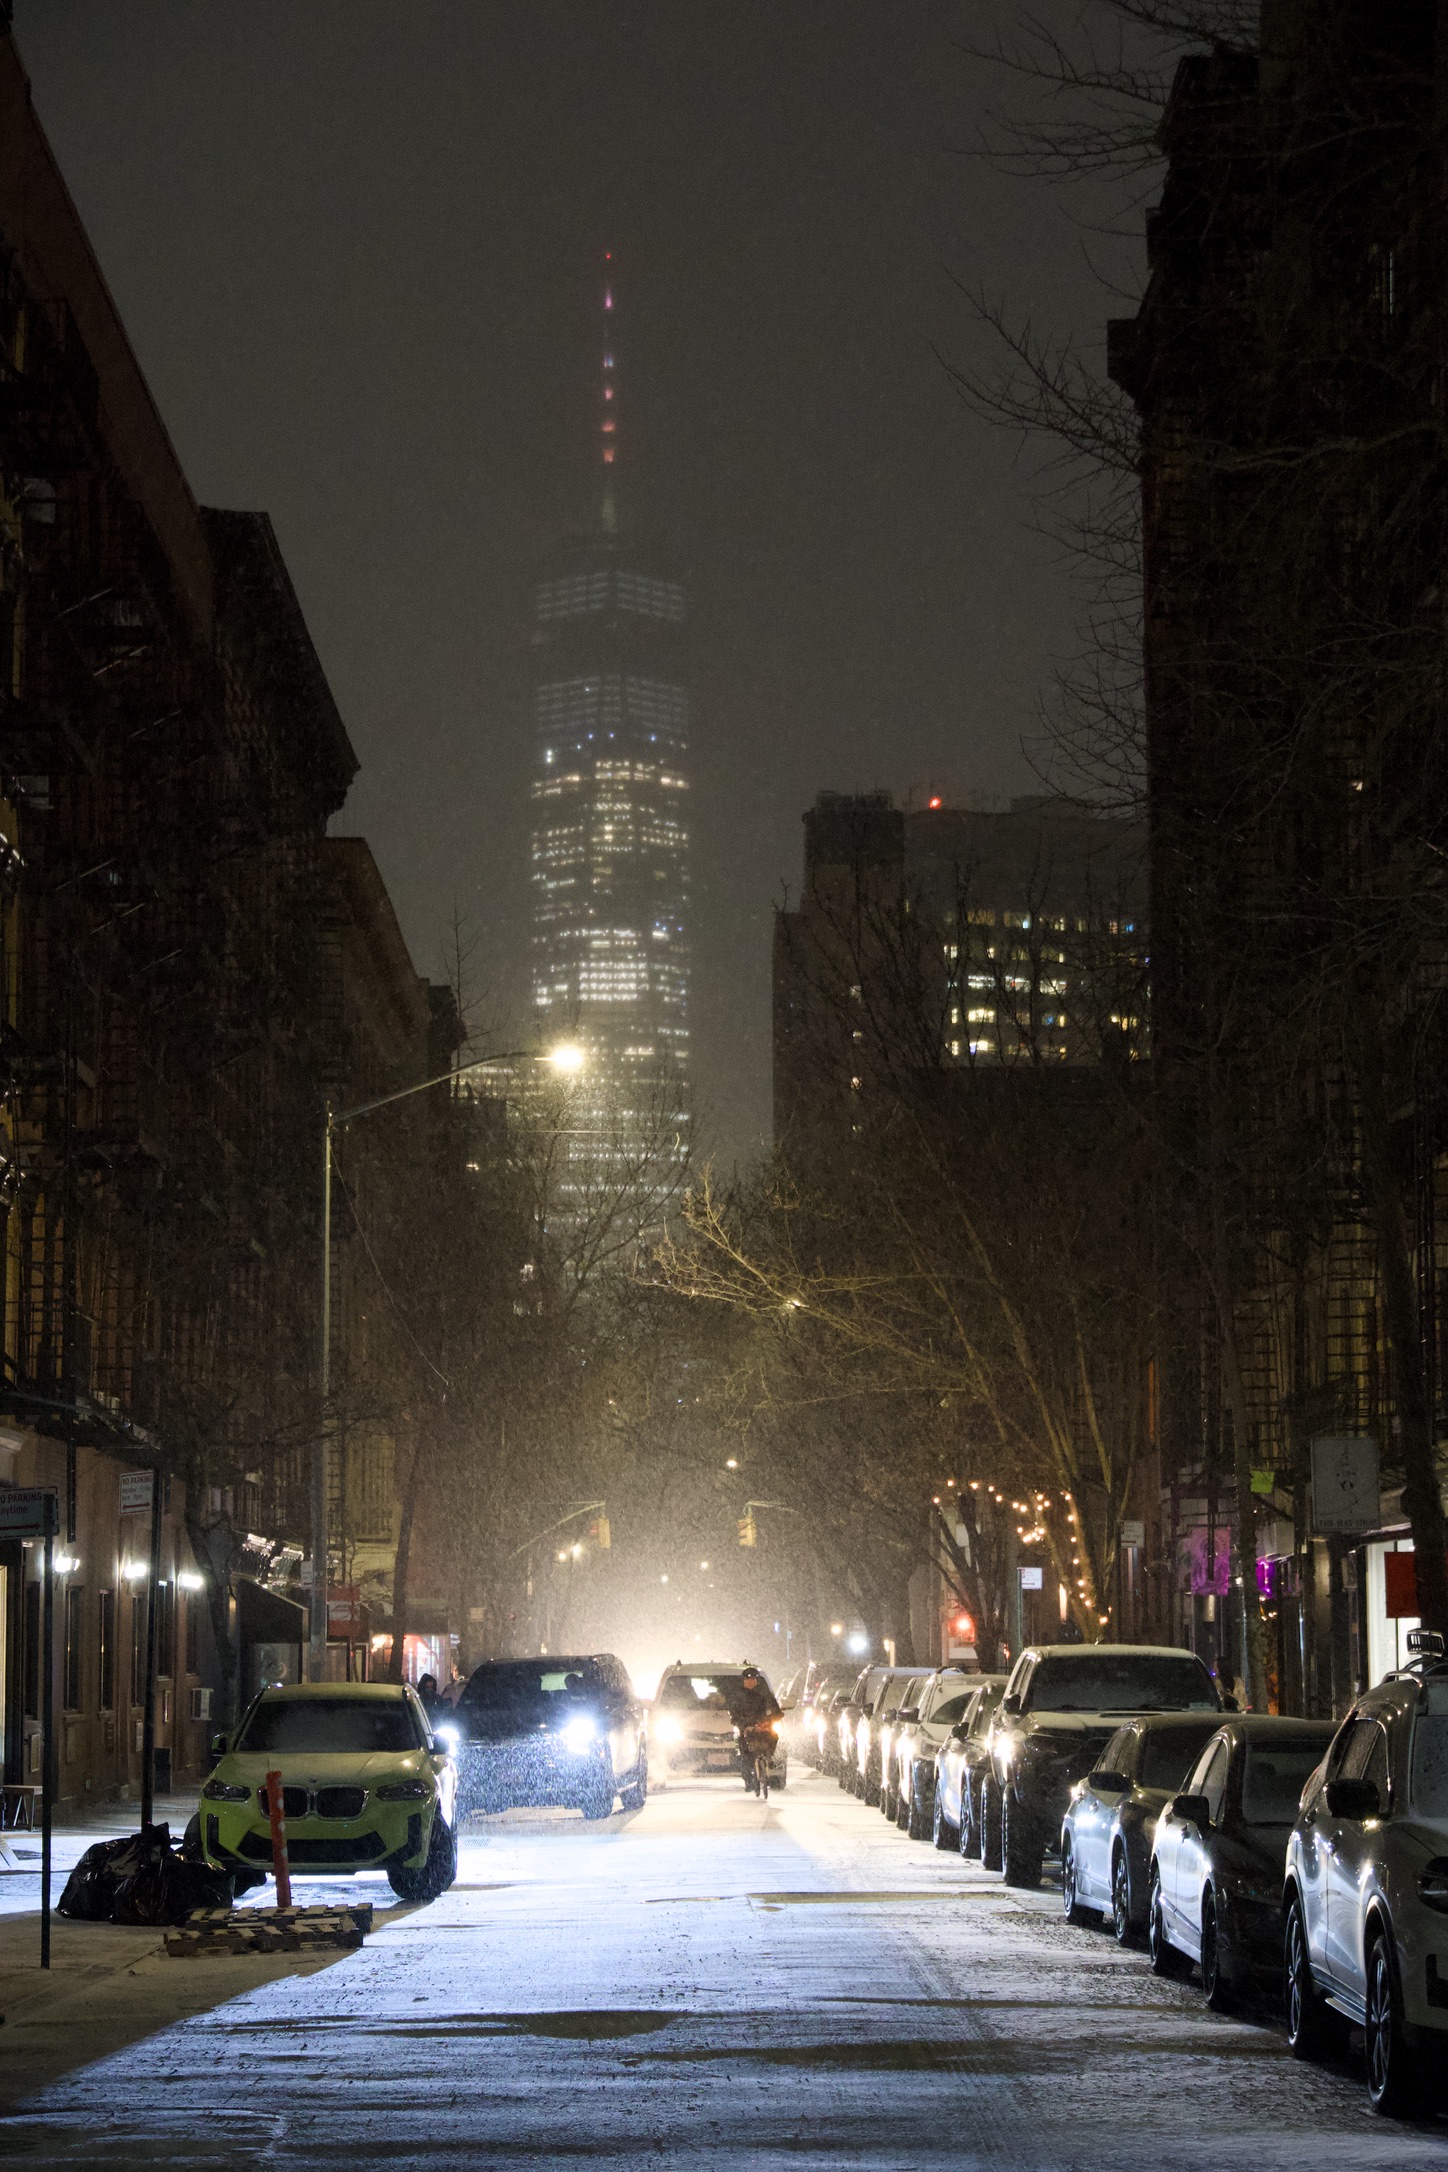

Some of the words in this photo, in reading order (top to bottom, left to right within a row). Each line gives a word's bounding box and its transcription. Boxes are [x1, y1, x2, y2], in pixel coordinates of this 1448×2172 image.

[0, 1494, 6, 1504] O
[8, 1492, 42, 1503] PARKING
[0, 1505, 28, 1517] nytime
